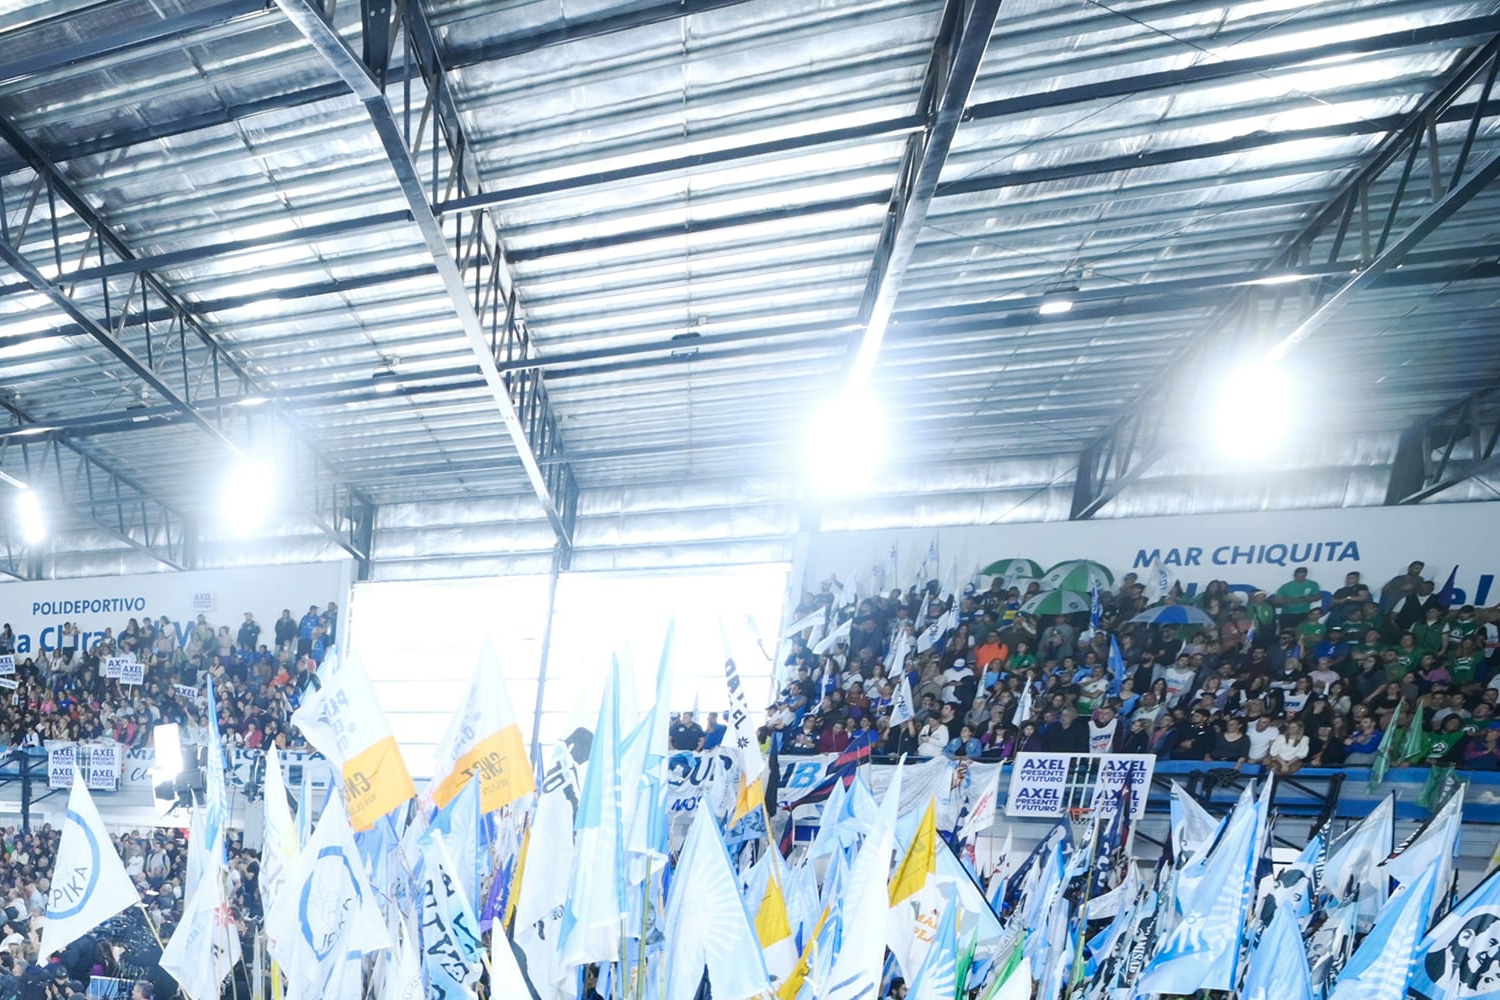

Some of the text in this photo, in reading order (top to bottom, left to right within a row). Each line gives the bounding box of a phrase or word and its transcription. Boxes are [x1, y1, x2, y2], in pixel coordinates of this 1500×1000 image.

[1133, 541, 1361, 569] MAR CHIQUITA
[194, 593, 211, 601] AXEL
[32, 597, 145, 615] POLIDEPORTIVO
[176, 687, 196, 697] AXEL
[53, 748, 75, 757] AXEL
[93, 748, 115, 757] AXEL
[1023, 759, 1066, 770] AXEL
[1103, 760, 1147, 771] AXEL
[52, 768, 74, 776] AXEL
[92, 769, 114, 777] AXEL
[1017, 788, 1060, 800] AXEL
[46, 867, 88, 908] PIKA
